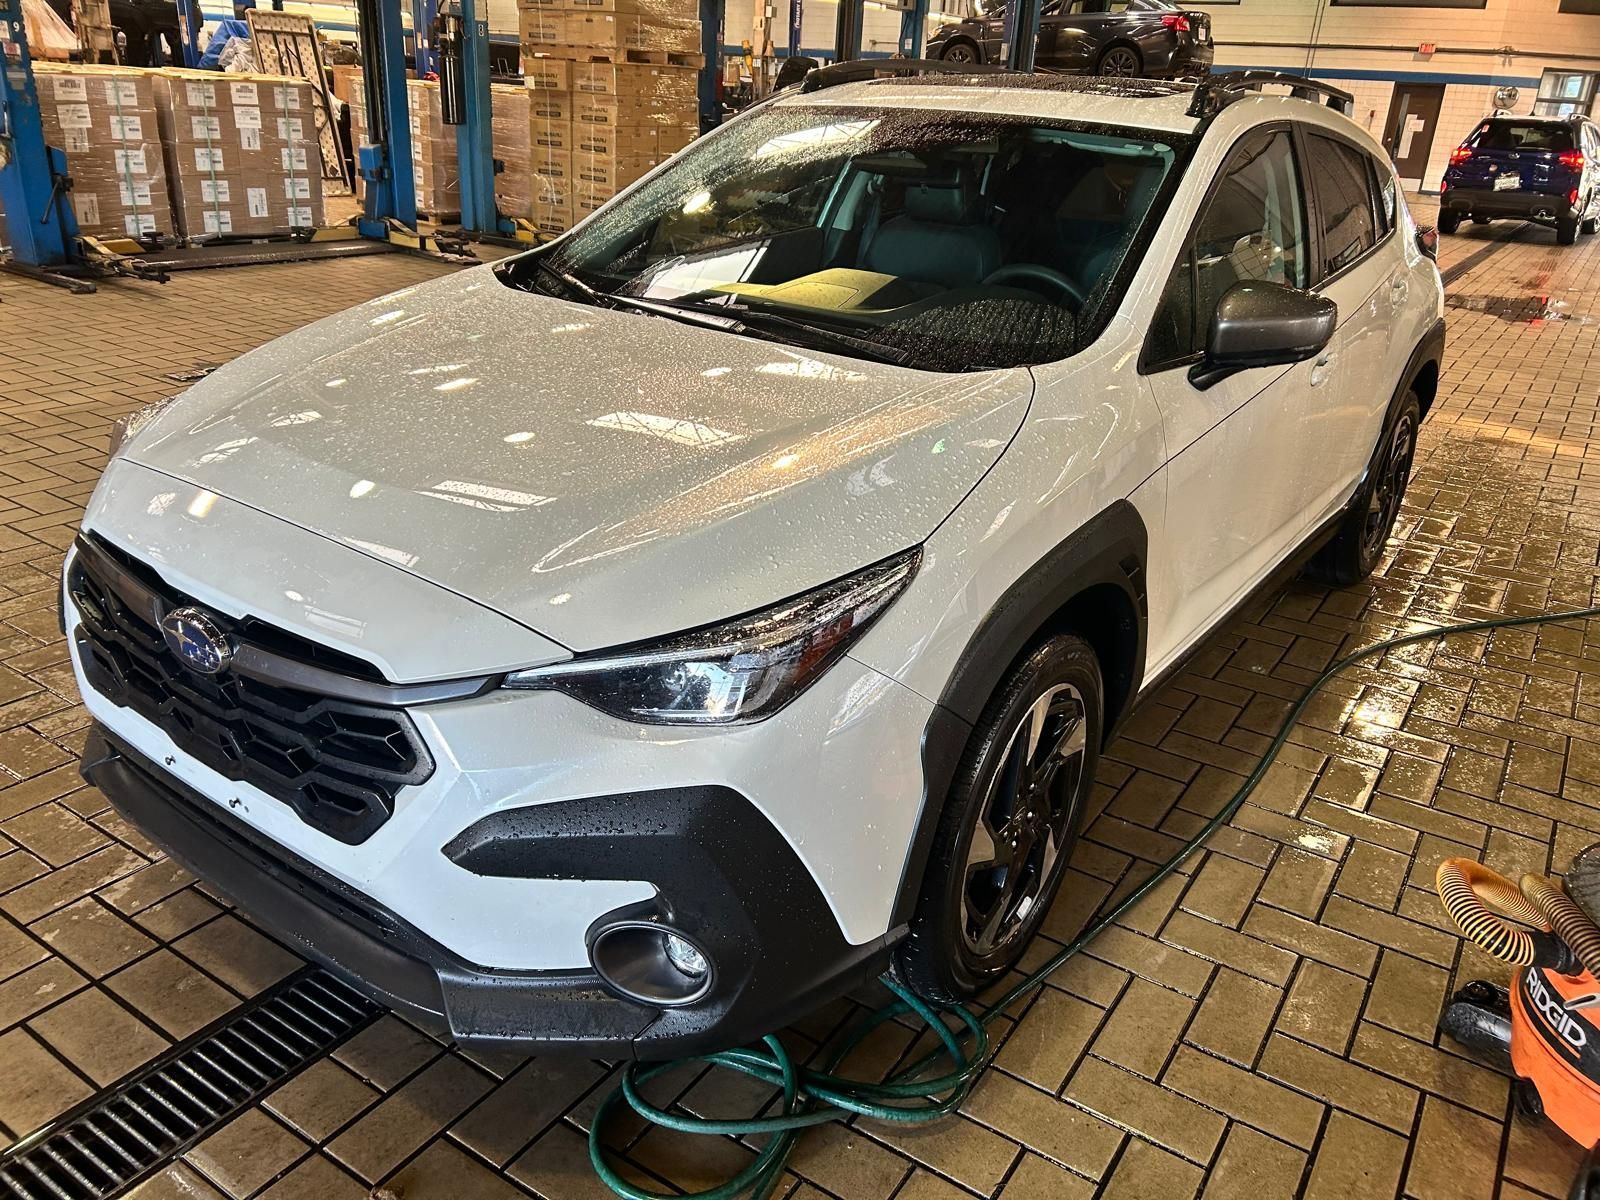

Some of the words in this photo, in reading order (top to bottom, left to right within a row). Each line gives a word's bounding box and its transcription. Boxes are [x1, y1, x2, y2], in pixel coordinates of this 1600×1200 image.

[13, 21, 20, 32] 9
[1420, 43, 1436, 53] EXIT
[587, 166, 607, 174] SUBARU
[1526, 966, 1587, 1047] RIDGID
